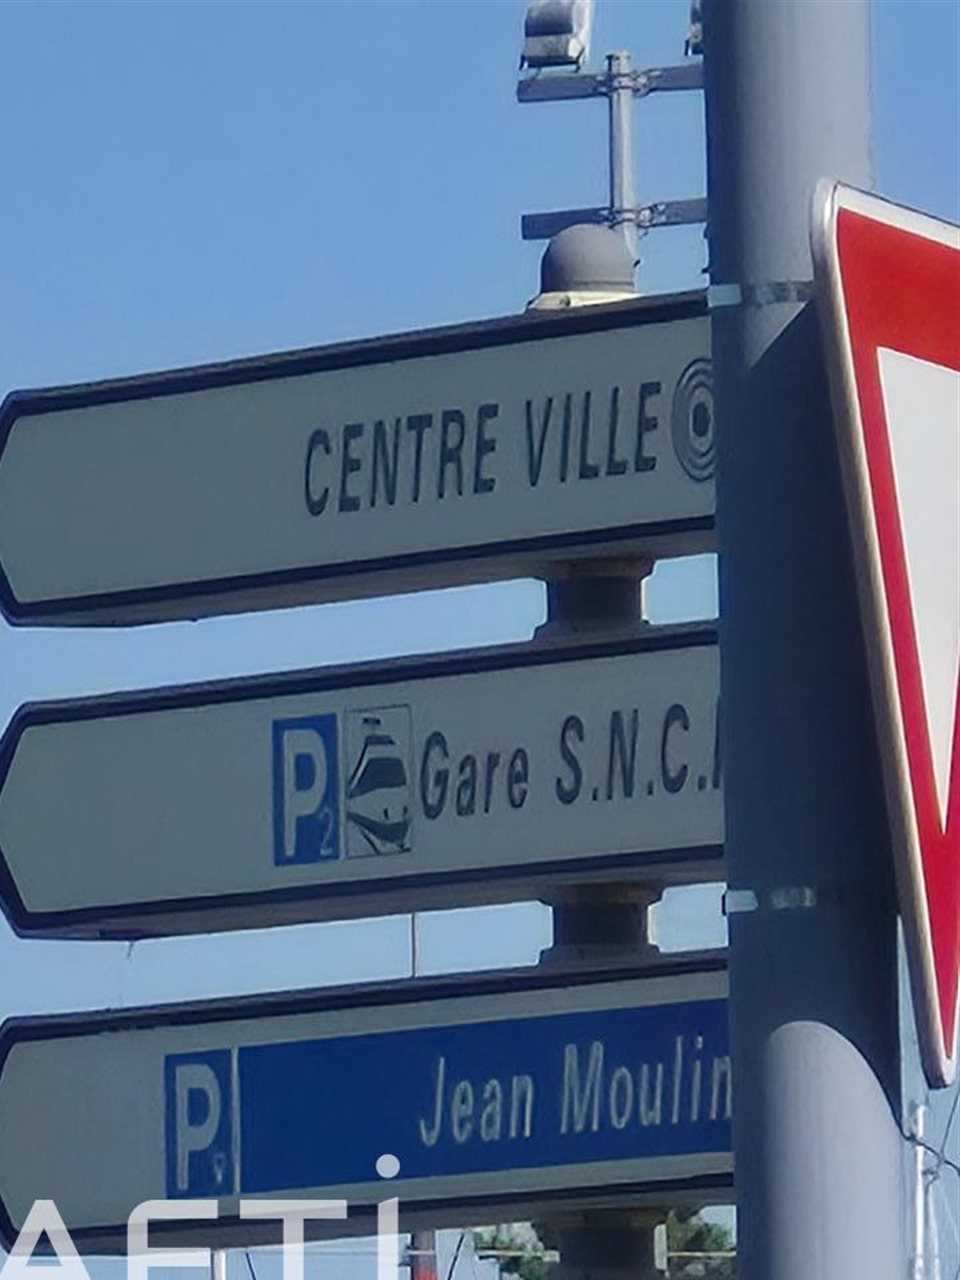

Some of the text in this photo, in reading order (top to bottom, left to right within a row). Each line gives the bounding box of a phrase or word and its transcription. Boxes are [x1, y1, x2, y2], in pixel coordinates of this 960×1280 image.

[305, 381, 661, 517] CENTRE VILLE
[420, 703, 722, 820] Gare S.N.C.
[420, 1036, 732, 1146] Jean Moulin
